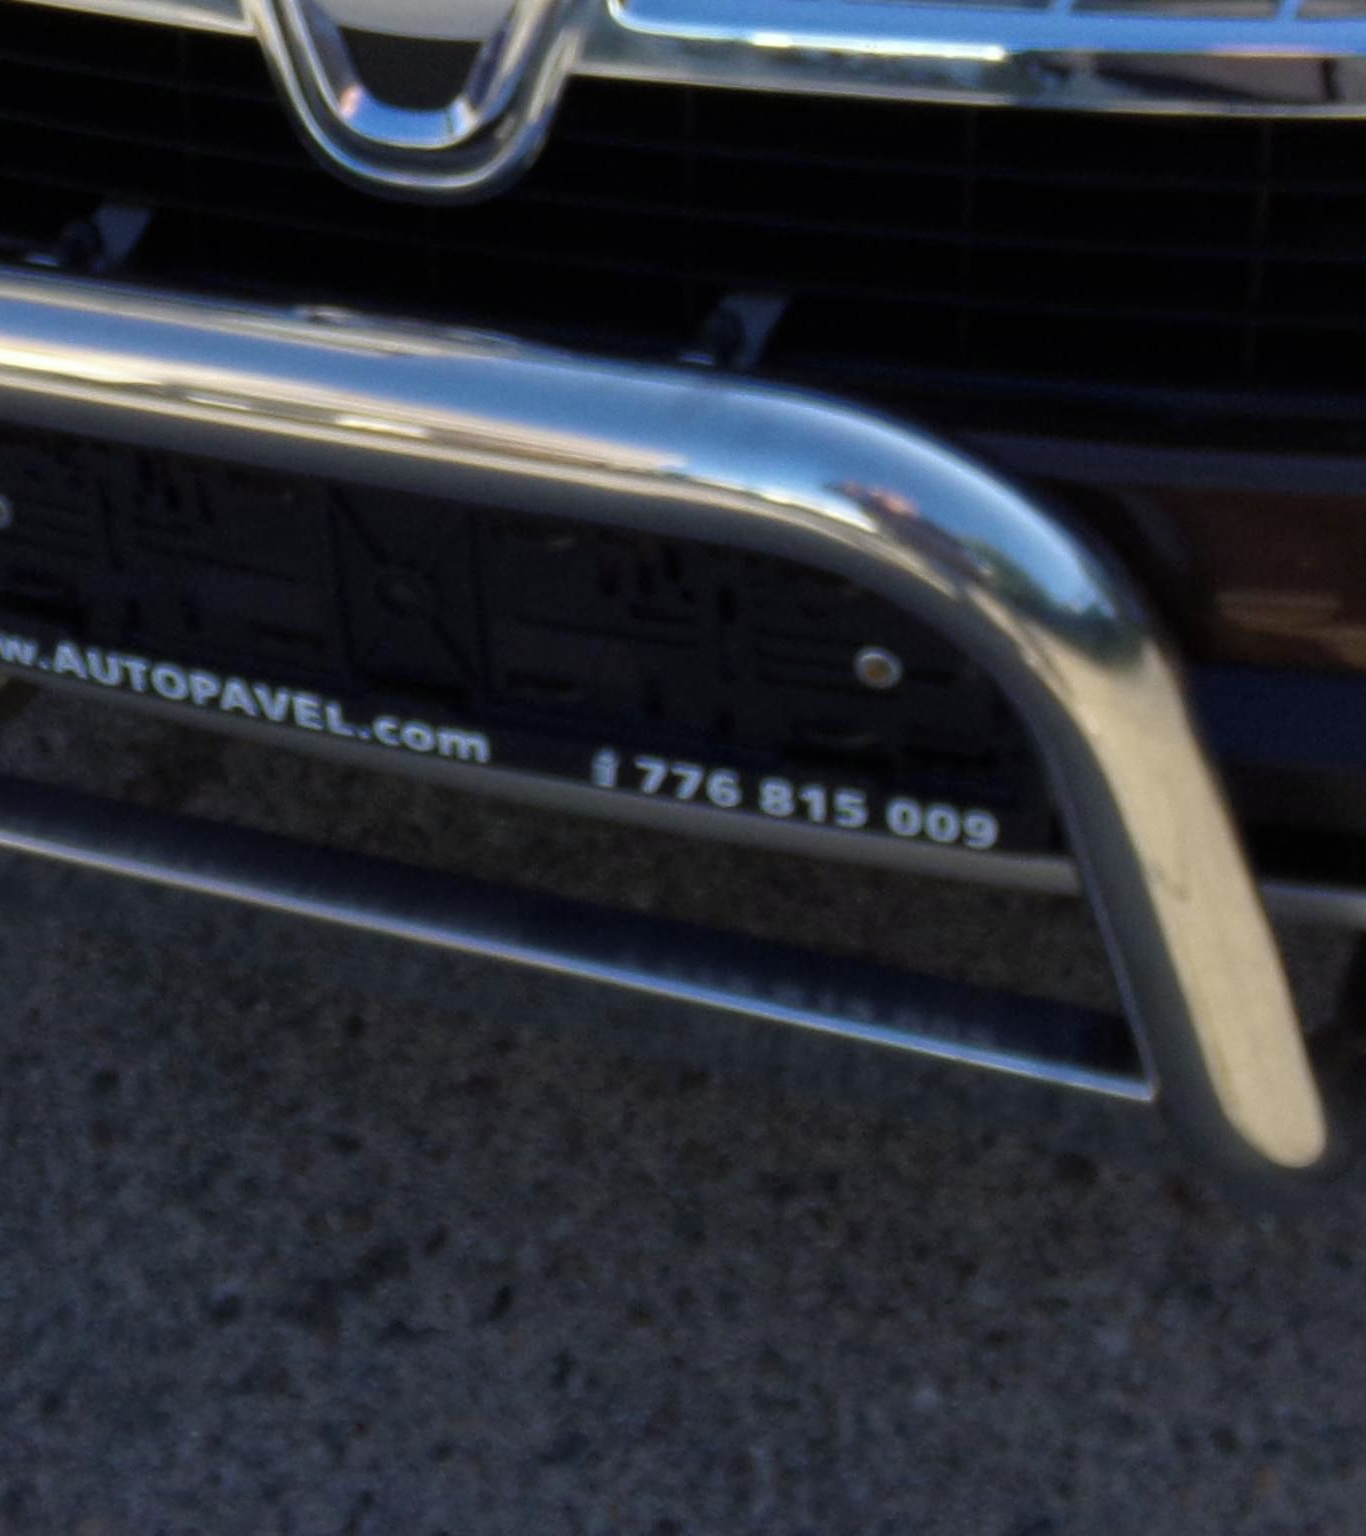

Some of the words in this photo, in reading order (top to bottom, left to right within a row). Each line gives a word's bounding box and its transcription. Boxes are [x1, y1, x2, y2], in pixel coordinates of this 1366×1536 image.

[636, 757, 742, 808] 776
[758, 777, 869, 829] 815
[885, 797, 1001, 850] 009
